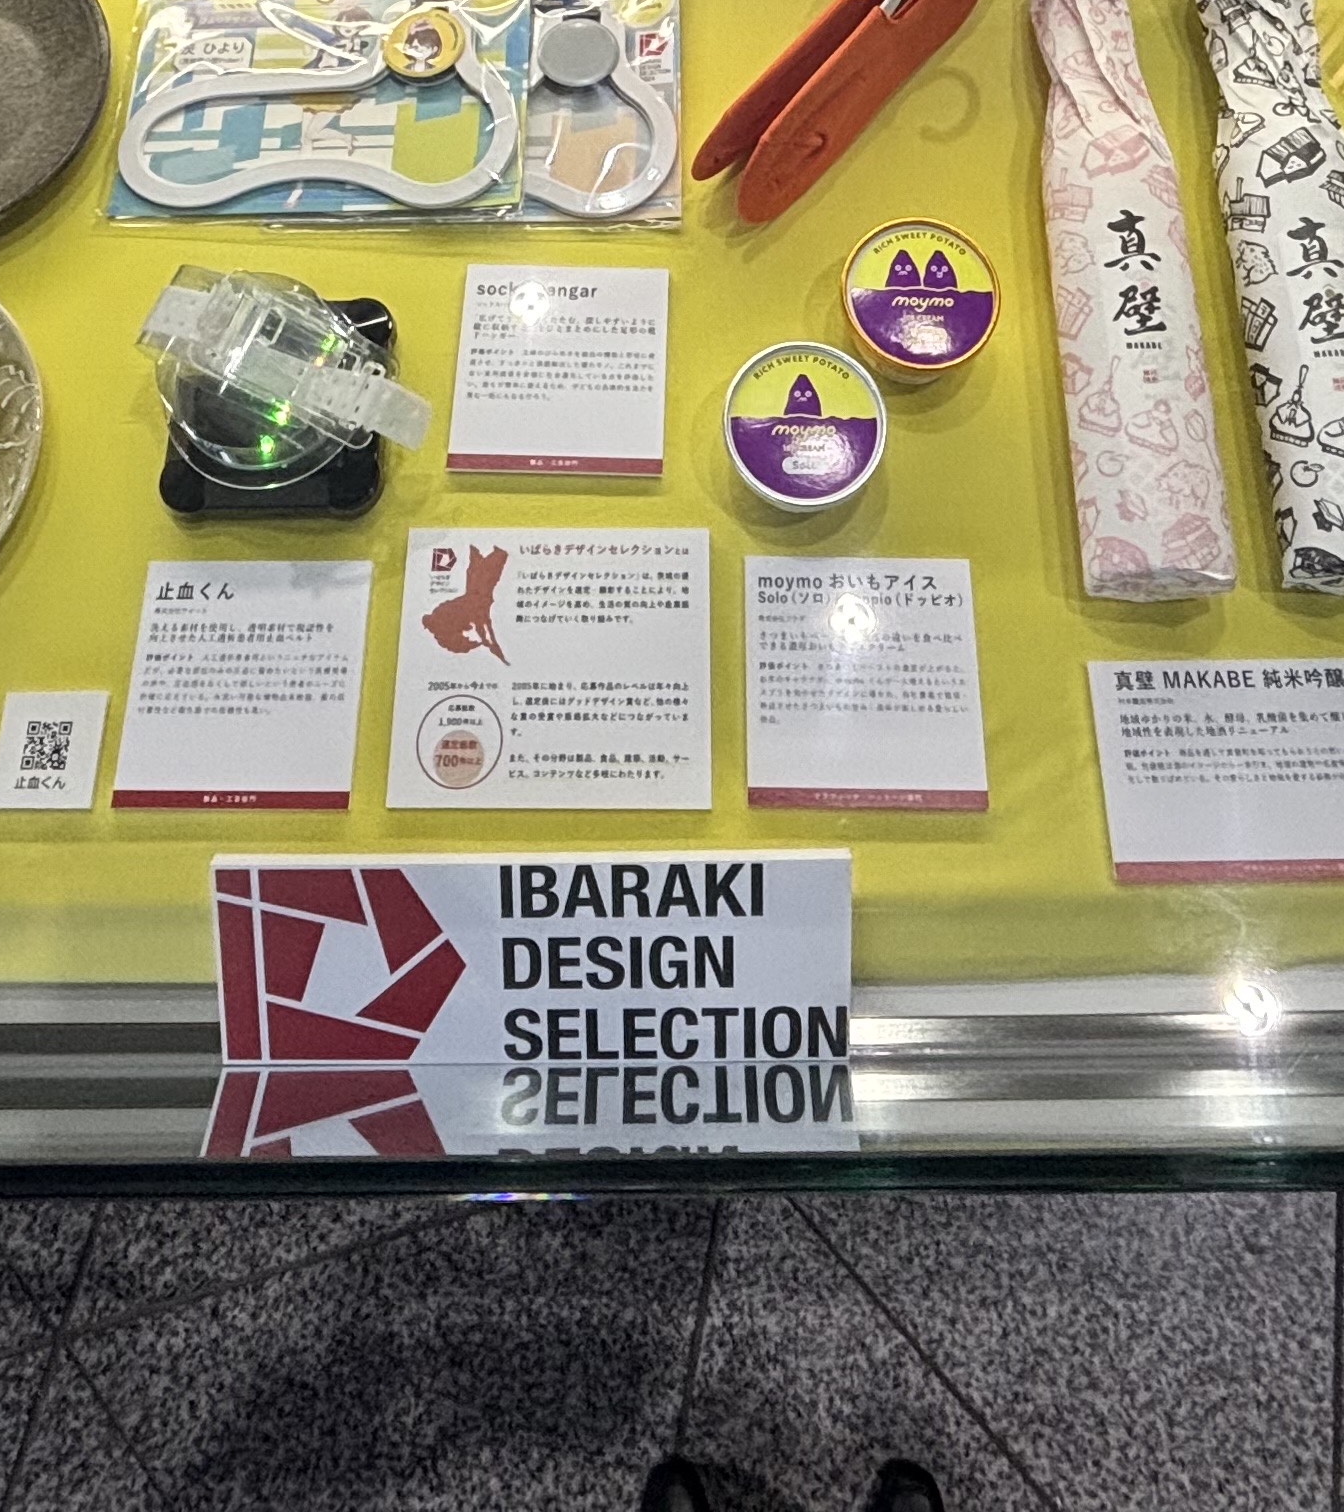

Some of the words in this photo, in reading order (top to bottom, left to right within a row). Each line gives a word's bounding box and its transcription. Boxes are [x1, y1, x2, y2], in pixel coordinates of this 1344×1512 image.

[872, 237, 894, 255] RICH
[895, 231, 927, 242] SWEET
[929, 232, 967, 256] POTATO
[1104, 209, 1167, 337] 真壁
[891, 295, 955, 312] moymo
[753, 361, 775, 380] RICH
[776, 355, 810, 367] SWEET
[812, 356, 850, 380] POTATO
[771, 424, 837, 438] moymo
[156, 580, 235, 601] 止血くん
[757, 576, 823, 592] moymo
[828, 573, 938, 591] おいもアイス
[1113, 670, 1157, 692] 真壁
[1162, 669, 1256, 690] MAKABE
[13, 775, 67, 791] 止血くん
[500, 863, 764, 919] IBARAKI
[501, 935, 735, 991] DESIGN
[503, 1005, 849, 1061] SELECTION
